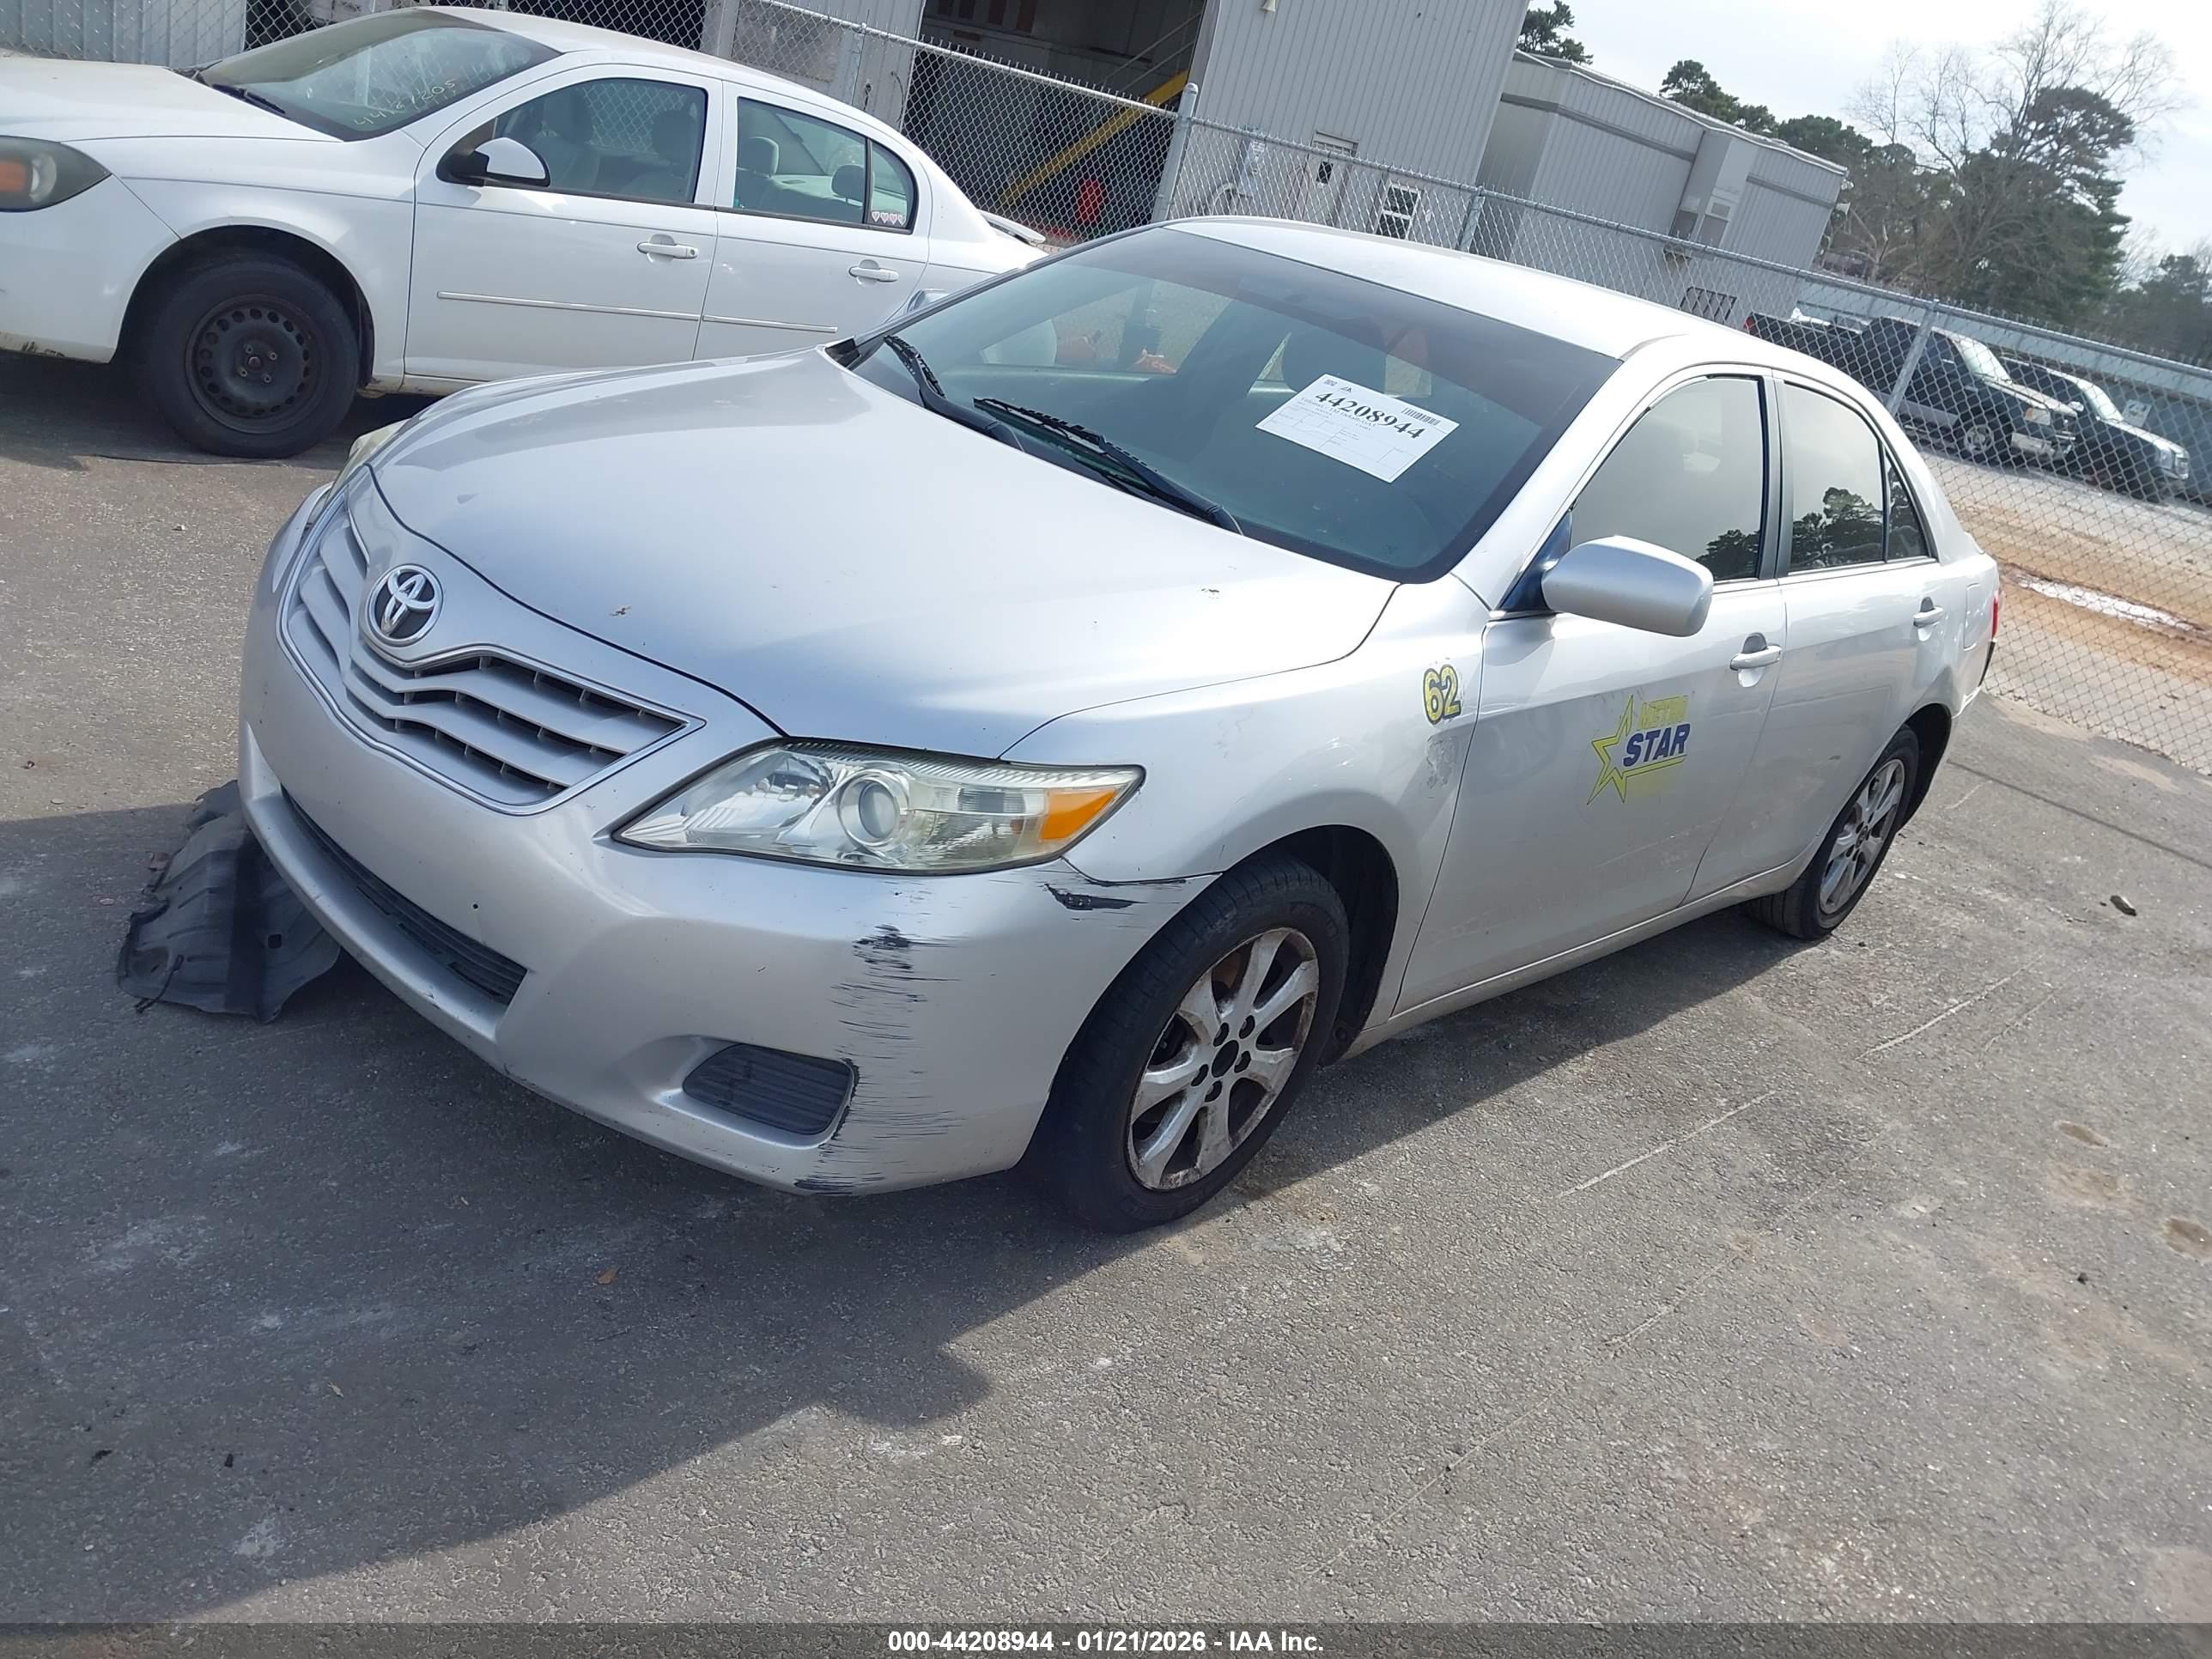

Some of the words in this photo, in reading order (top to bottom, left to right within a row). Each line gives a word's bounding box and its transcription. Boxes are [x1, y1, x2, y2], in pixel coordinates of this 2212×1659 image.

[1315, 392, 1426, 440] 44208944
[1423, 664, 1462, 726] 62
[1623, 724, 1691, 768] STAR
